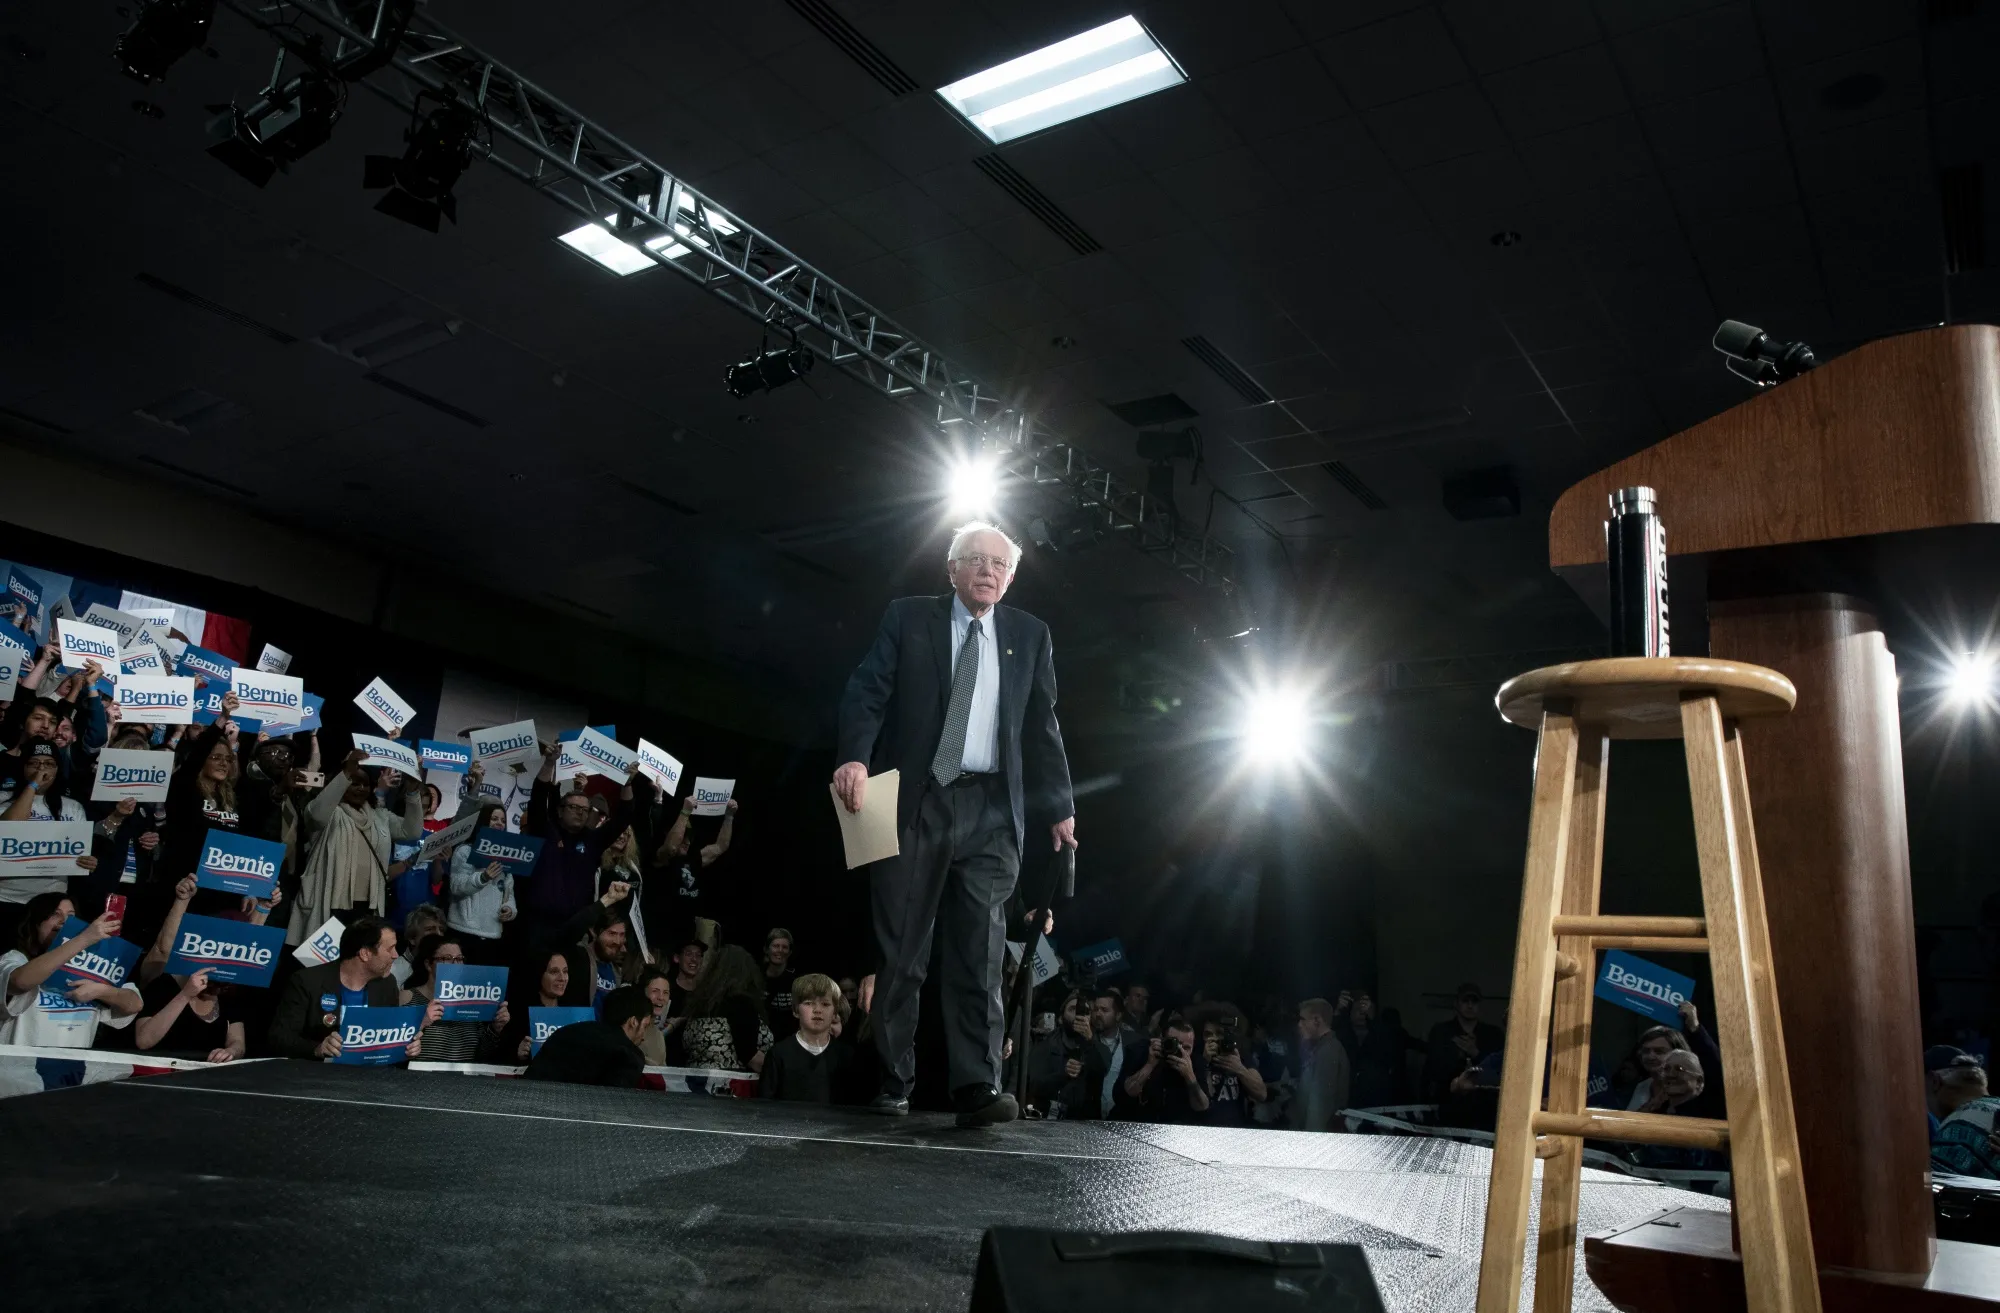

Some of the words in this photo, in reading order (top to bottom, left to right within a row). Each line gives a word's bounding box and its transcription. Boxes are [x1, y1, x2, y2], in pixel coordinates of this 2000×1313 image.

[9, 575, 39, 604] Bernie
[84, 613, 132, 636] Bernie
[64, 633, 116, 658] Bernie
[184, 653, 231, 679] Bernie
[262, 652, 287, 670] Bernie
[120, 688, 188, 707] Bernie
[237, 682, 298, 706] Bernie
[366, 687, 404, 724] Bernie
[360, 743, 415, 766] Bernie
[422, 747, 468, 763] Bernie
[477, 734, 533, 756] Bernie
[579, 738, 629, 773] Bernie
[101, 764, 166, 783] Bernie
[640, 749, 677, 781] Bernie
[697, 788, 731, 801] Bernie
[1, 836, 85, 856] Bernie
[478, 839, 535, 863] Bernie
[205, 847, 275, 878] Bernie
[179, 931, 272, 966] Bernie
[66, 941, 125, 985] ernie
[439, 980, 502, 1001] Bernie
[1606, 963, 1684, 1007] Bernie
[343, 1021, 416, 1045] Bernie
